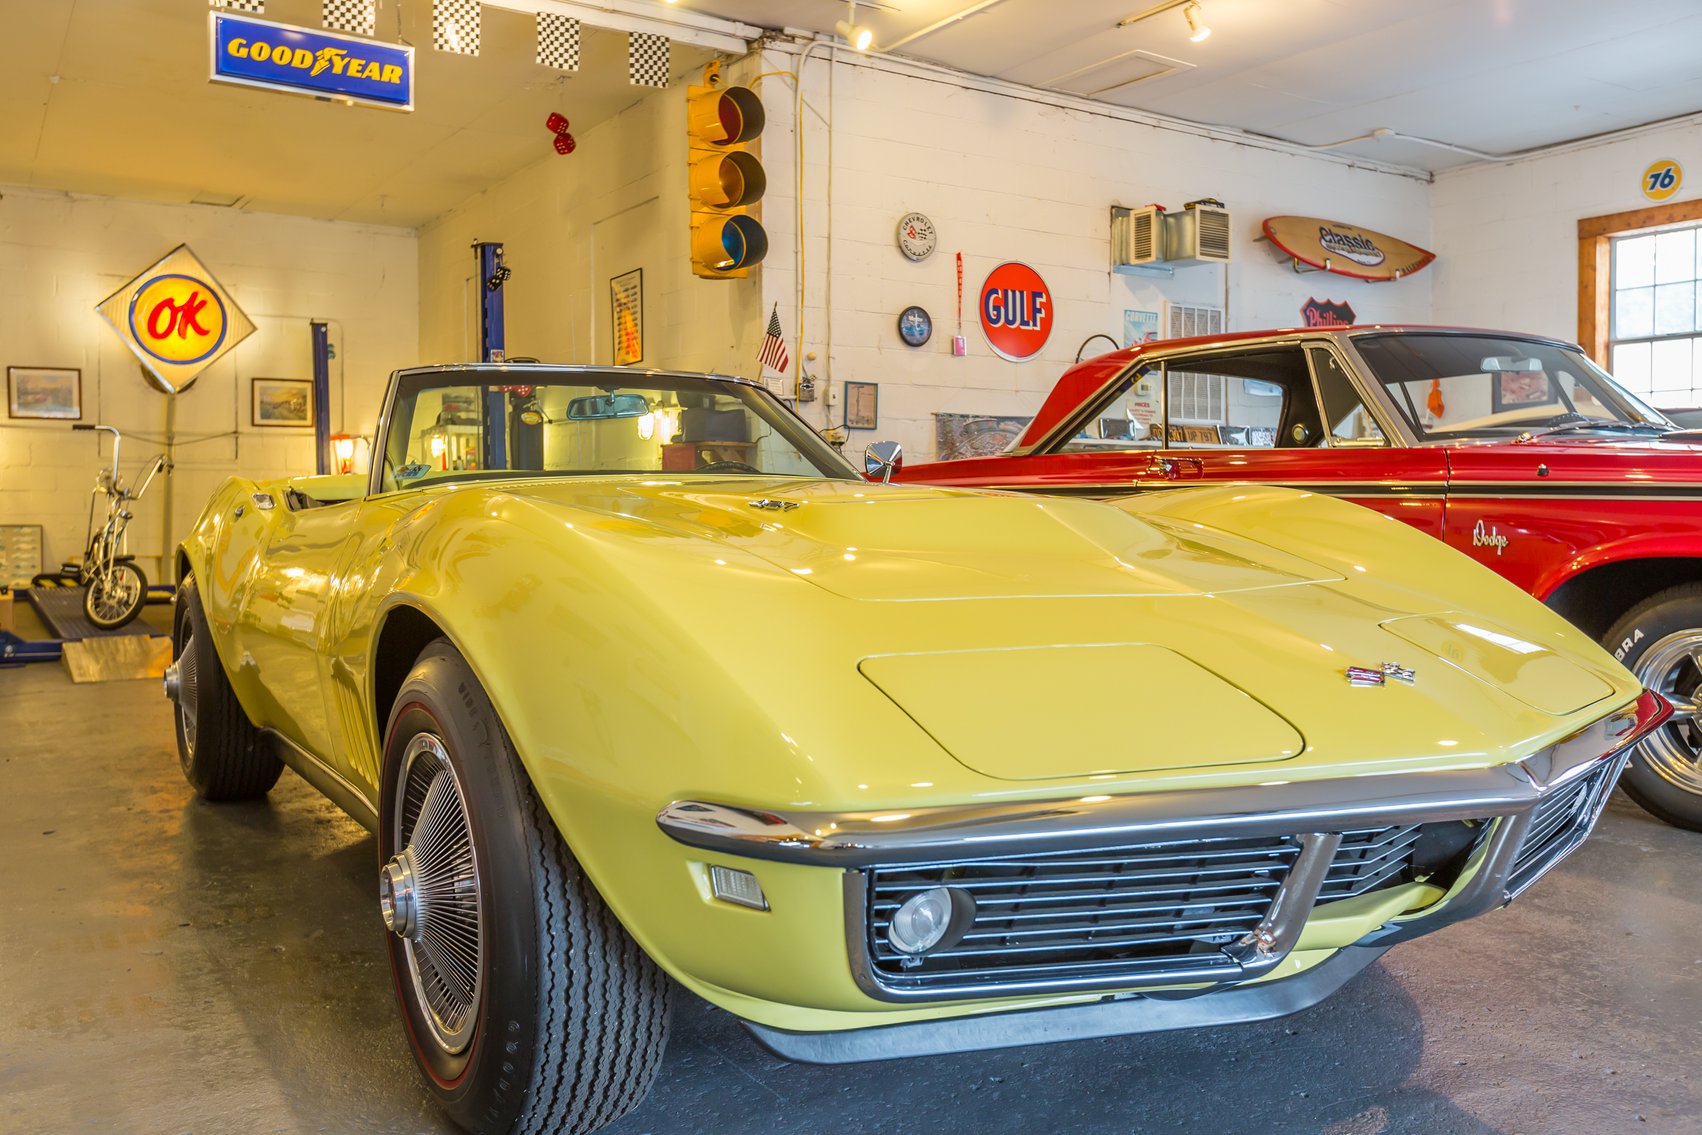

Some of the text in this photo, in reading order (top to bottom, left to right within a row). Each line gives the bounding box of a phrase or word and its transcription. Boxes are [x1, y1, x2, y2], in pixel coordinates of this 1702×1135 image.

[227, 37, 403, 84] GOODYEAR
[1648, 167, 1675, 191] 76
[902, 216, 934, 235] CHEVROLET
[1319, 226, 1376, 251] Classic
[147, 291, 210, 340] OK
[984, 287, 1047, 330] GULF
[1473, 519, 1508, 555] Dodge
